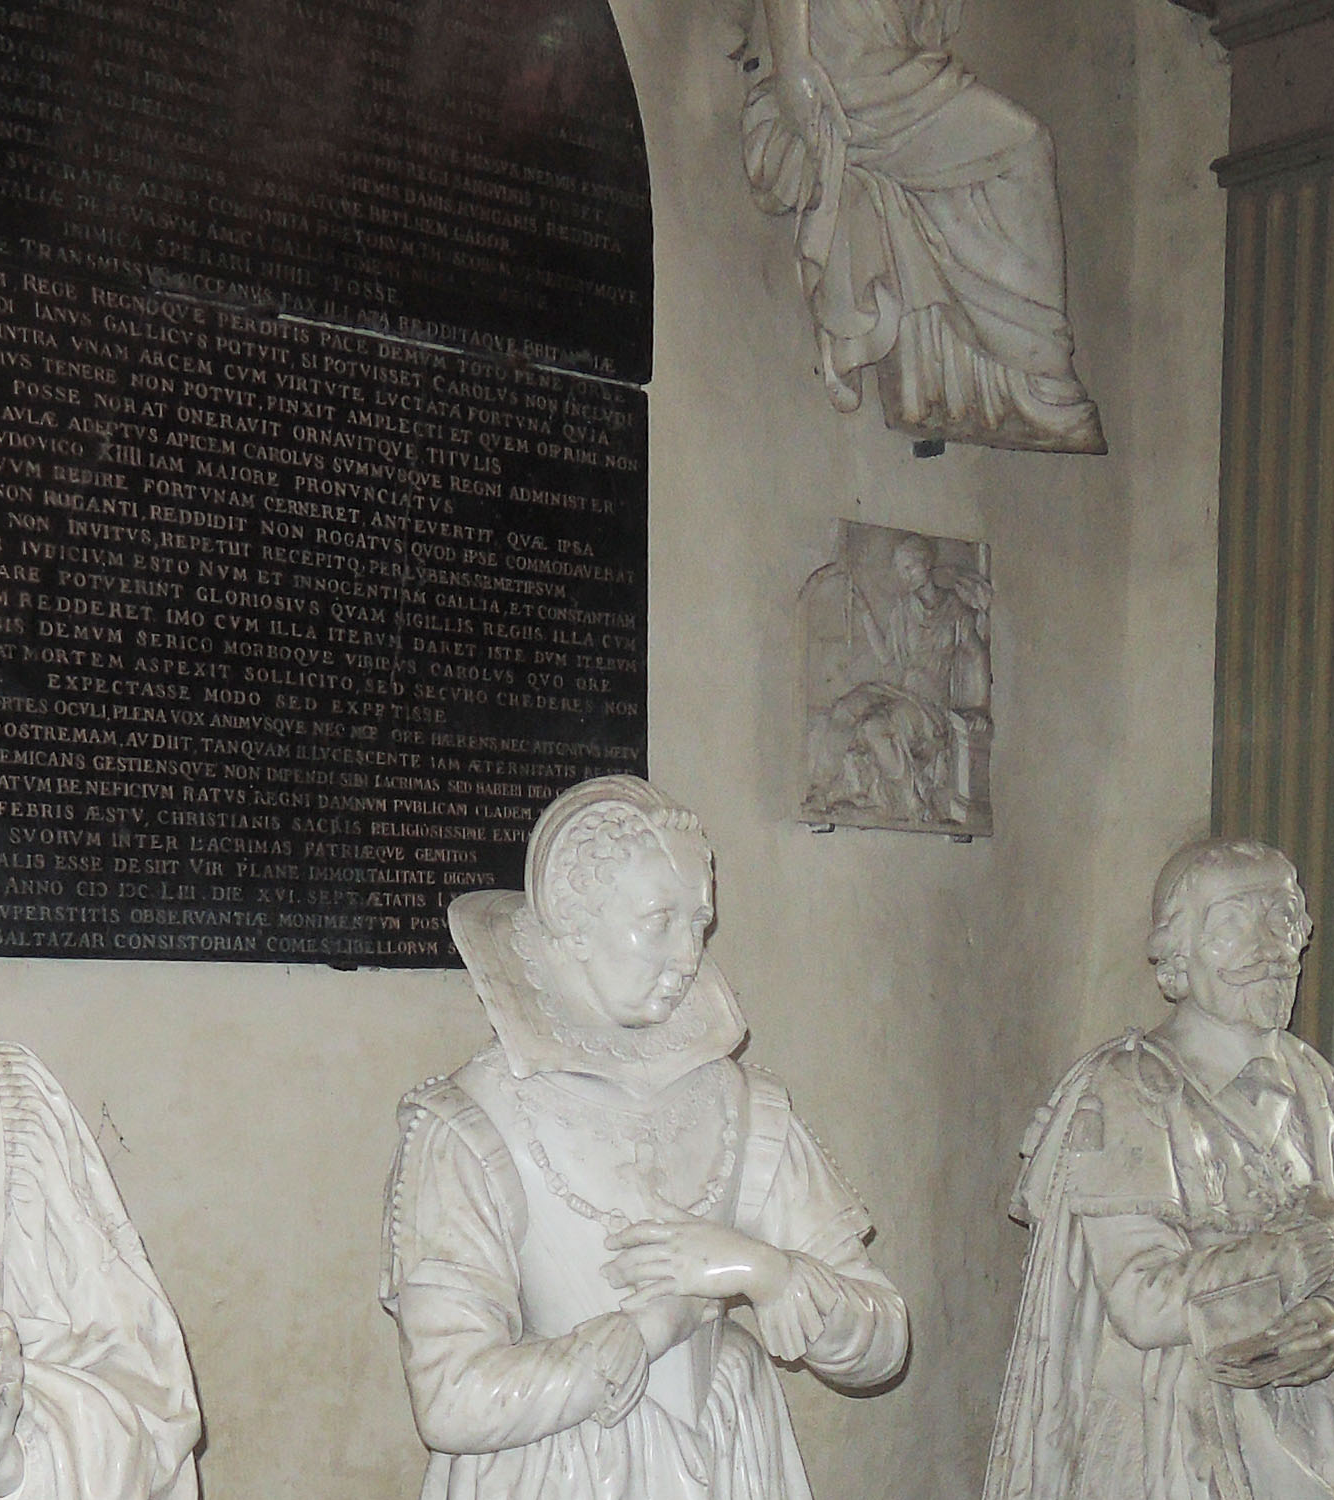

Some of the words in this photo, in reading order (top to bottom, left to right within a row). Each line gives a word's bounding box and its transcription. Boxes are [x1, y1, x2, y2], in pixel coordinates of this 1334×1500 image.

[23, 273, 77, 298] REGE
[219, 312, 310, 343] PERDITIS
[320, 331, 367, 354] PACE
[105, 314, 206, 349] GALLICVS
[302, 352, 317, 369] SI
[324, 356, 422, 387] POTVISSET
[433, 374, 517, 404] CAROLVS
[42, 356, 115, 383] TENERE
[131, 372, 173, 392] NON
[451, 427, 470, 443] ET
[479, 432, 528, 453] QVEM
[72, 336, 127, 360] VNAM
[139, 348, 212, 375] ARCEM
[224, 363, 265, 384] CVM
[275, 372, 363, 401] VIRTVTE
[563, 423, 609, 446] QVIA
[13, 379, 79, 404] POSSE
[177, 406, 280, 436] ONERAVIT
[426, 447, 501, 474] TITVLIS
[149, 452, 183, 472] IAM
[197, 460, 278, 487] MAIORE
[295, 475, 453, 512] PRONVNCIATVS
[244, 443, 324, 469] CAROLVS
[450, 476, 501, 497] REGNI
[143, 478, 254, 507] FORTVNAM
[9, 512, 49, 530] NON
[150, 505, 247, 531] REDDIDIT
[260, 519, 303, 539] NON
[316, 527, 402, 553] ROGATVS
[411, 542, 455, 563] QVOD
[134, 554, 189, 575] ESTO
[198, 559, 247, 581] NVM
[258, 569, 283, 586] ET
[510, 601, 533, 617] ET
[196, 586, 319, 614] GLORIOSIVS
[331, 602, 385, 623] QVAM
[166, 608, 204, 626] IMO
[214, 613, 258, 632] CVM
[269, 619, 317, 639] ILLA
[39, 621, 121, 643] DEMVM
[136, 630, 213, 650] SERICO
[224, 640, 334, 667] MORBOQVE
[431, 662, 514, 684] CAROLVS
[527, 672, 563, 691] QVO
[135, 657, 230, 678] ASPEXIT
[48, 673, 190, 699] EXPECTASSE
[204, 687, 260, 705] MODO
[275, 694, 317, 710] SED
[171, 710, 204, 726] VOX
[0, 748, 85, 769] EMICANS
[224, 765, 258, 780] NON
[184, 786, 245, 804] RATVS
[9, 826, 100, 846] SVORVM
[157, 809, 280, 829] CHRISTIANIS
[55, 854, 101, 871] ESSE
[190, 859, 222, 876] VIR
